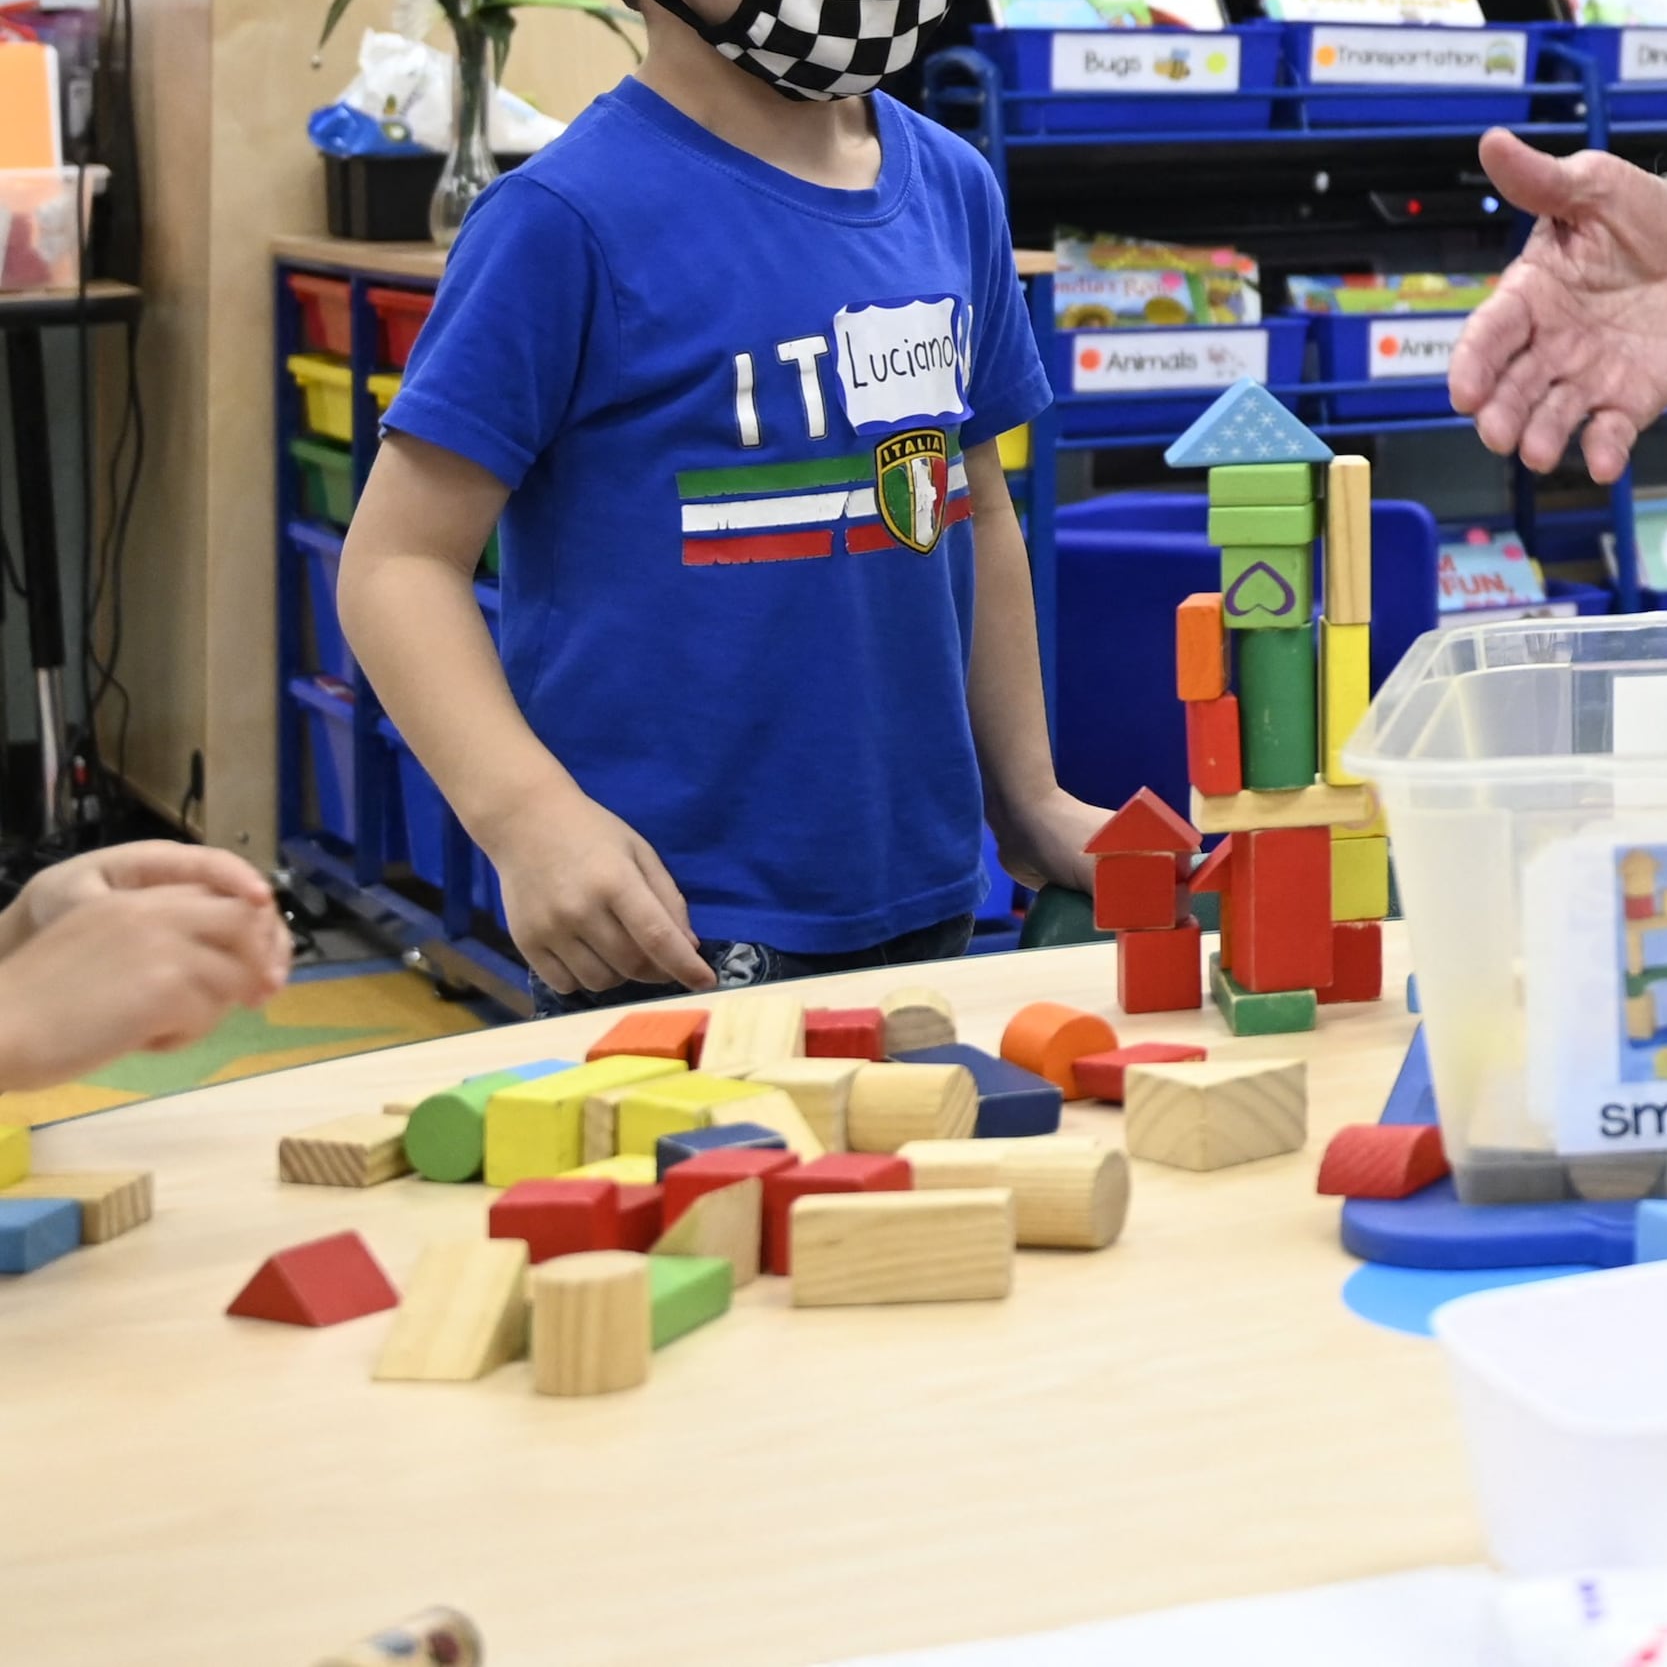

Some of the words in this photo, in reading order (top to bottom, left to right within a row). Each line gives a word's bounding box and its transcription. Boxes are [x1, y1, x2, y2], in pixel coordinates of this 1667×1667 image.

[1084, 50, 1142, 78] Bugs
[1337, 47, 1481, 69] Transportation
[845, 331, 955, 389] Luciano
[1106, 349, 1198, 373] Animals
[881, 435, 942, 464] ITALIA
